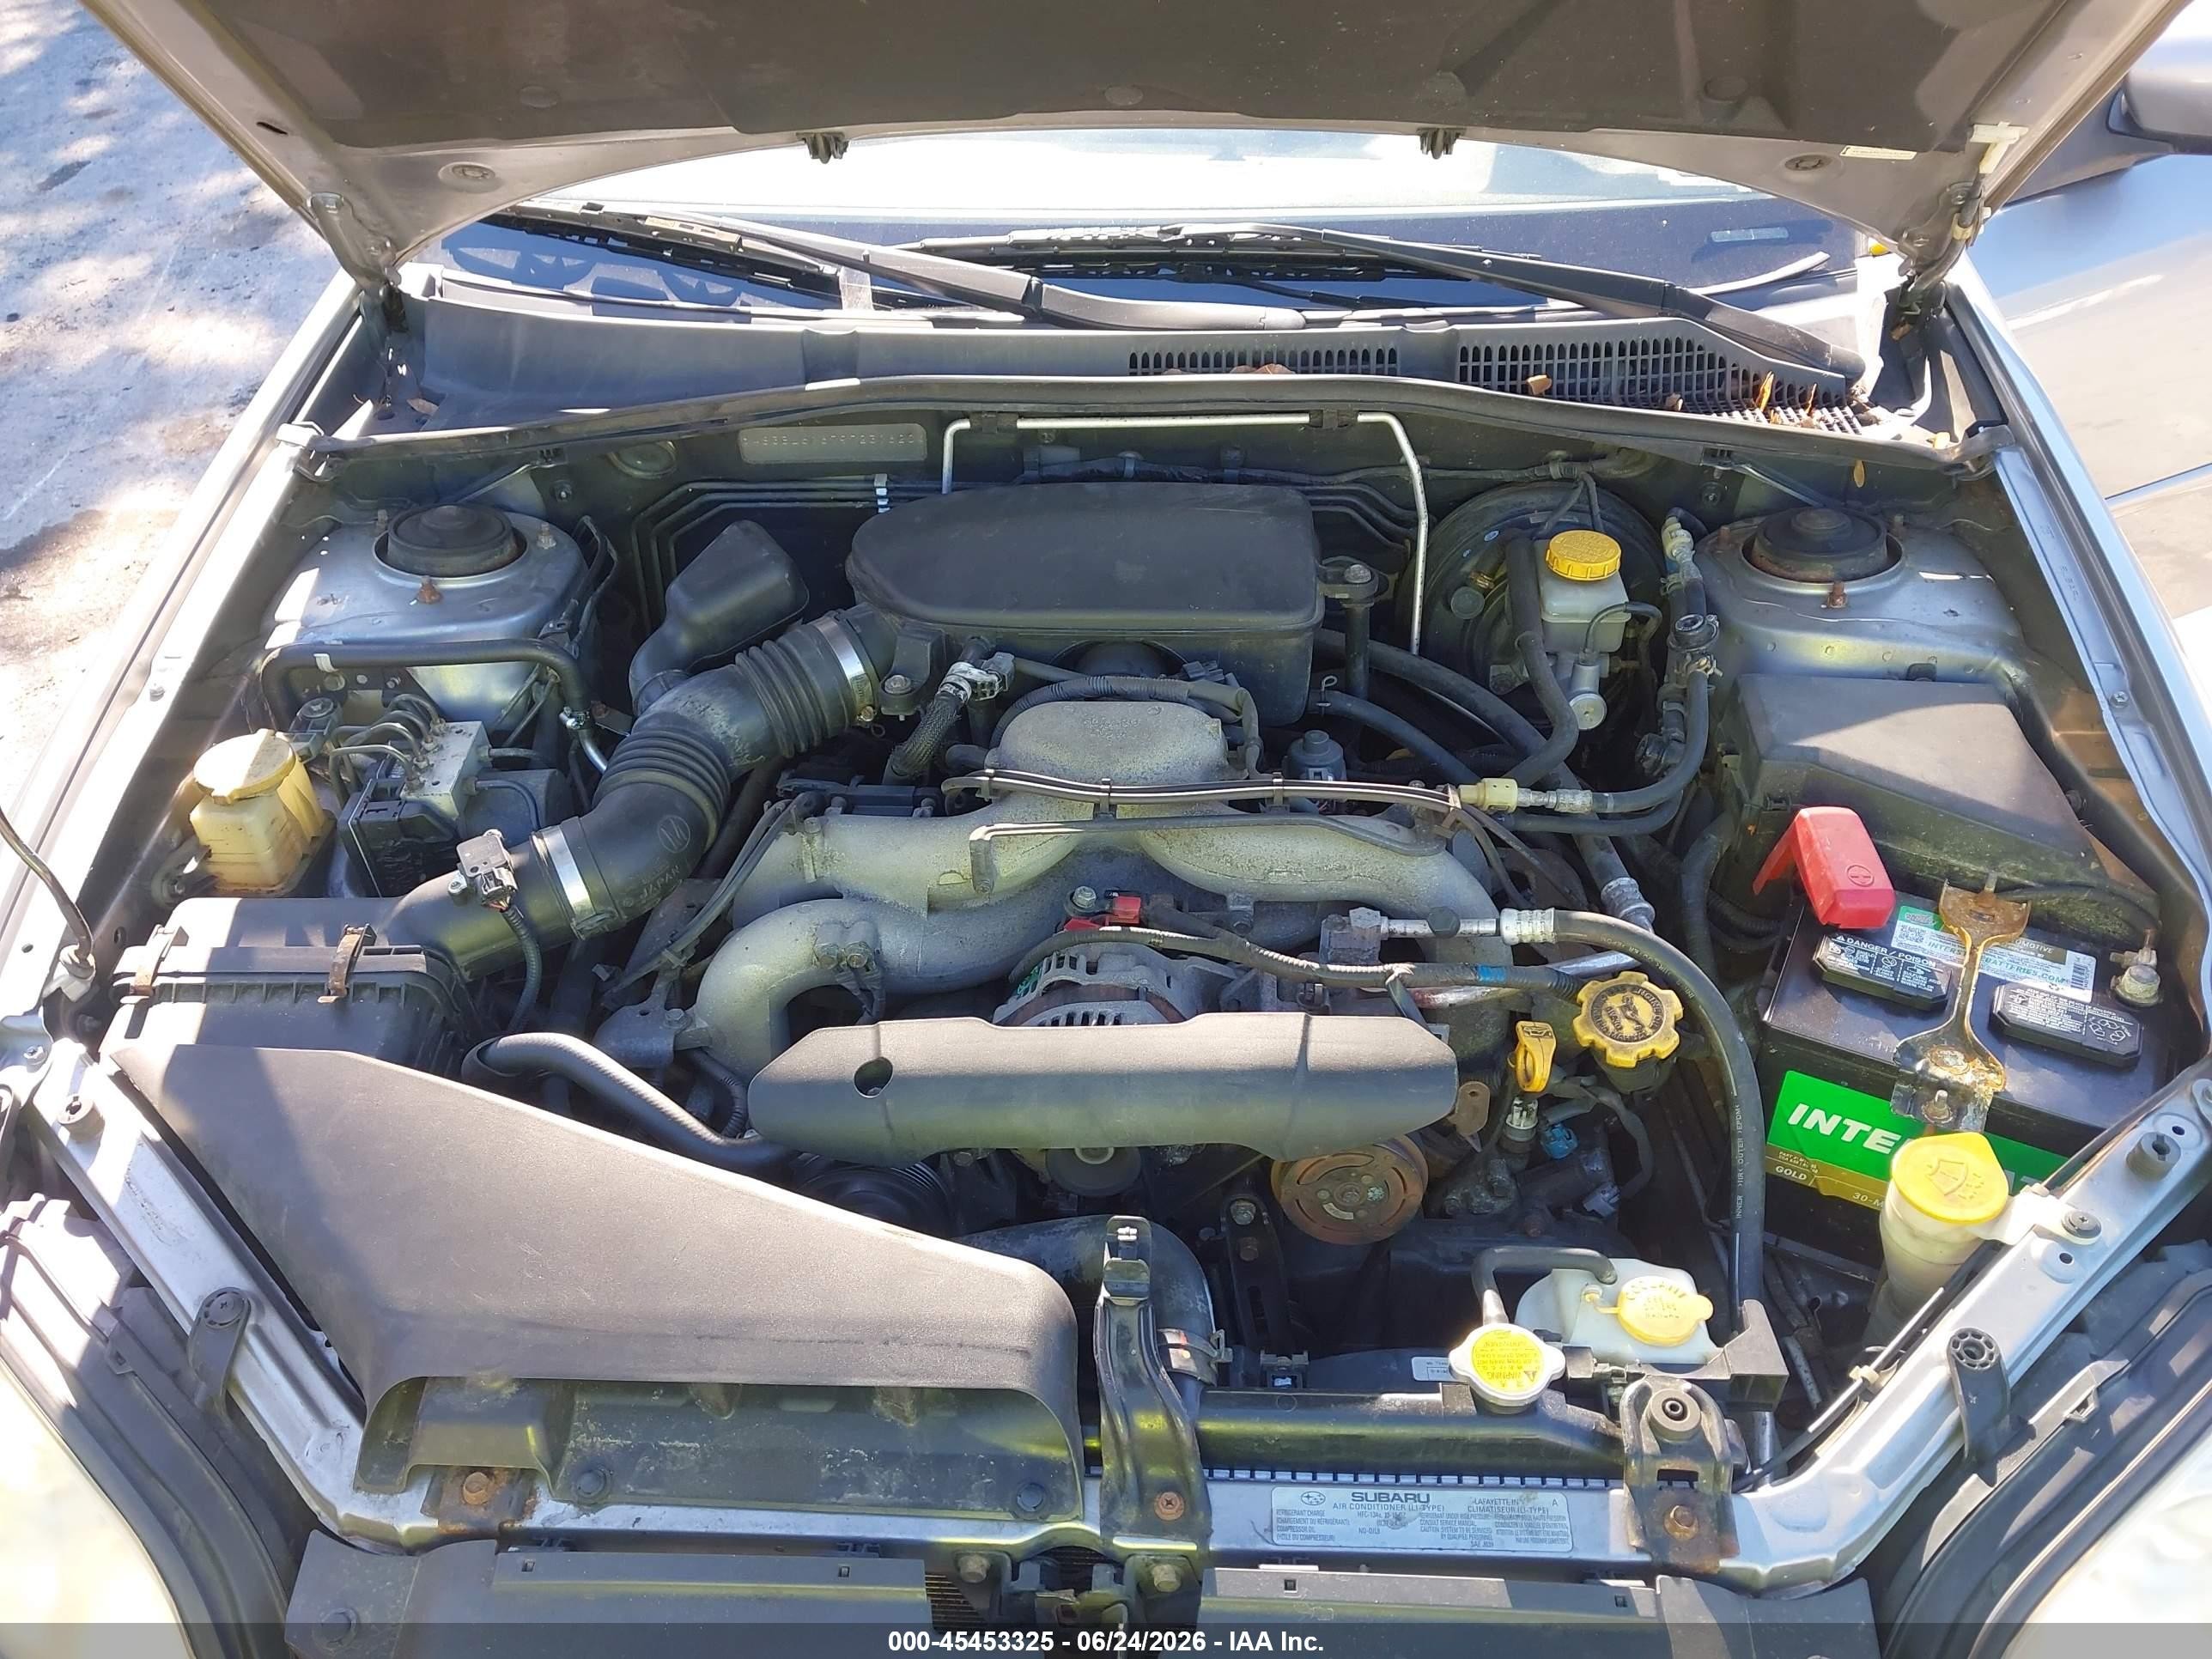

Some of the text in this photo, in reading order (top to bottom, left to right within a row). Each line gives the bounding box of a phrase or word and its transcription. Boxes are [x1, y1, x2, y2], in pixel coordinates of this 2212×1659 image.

[1846, 938, 1888, 954] DANGER
[1898, 952, 1936, 967] POISON
[1788, 1103, 1902, 1155] INTE
[1775, 1165, 1808, 1181] GOLD
[1351, 1492, 1431, 1504] SUBARU
[1349, 1503, 1407, 1511] CONDITIONER
